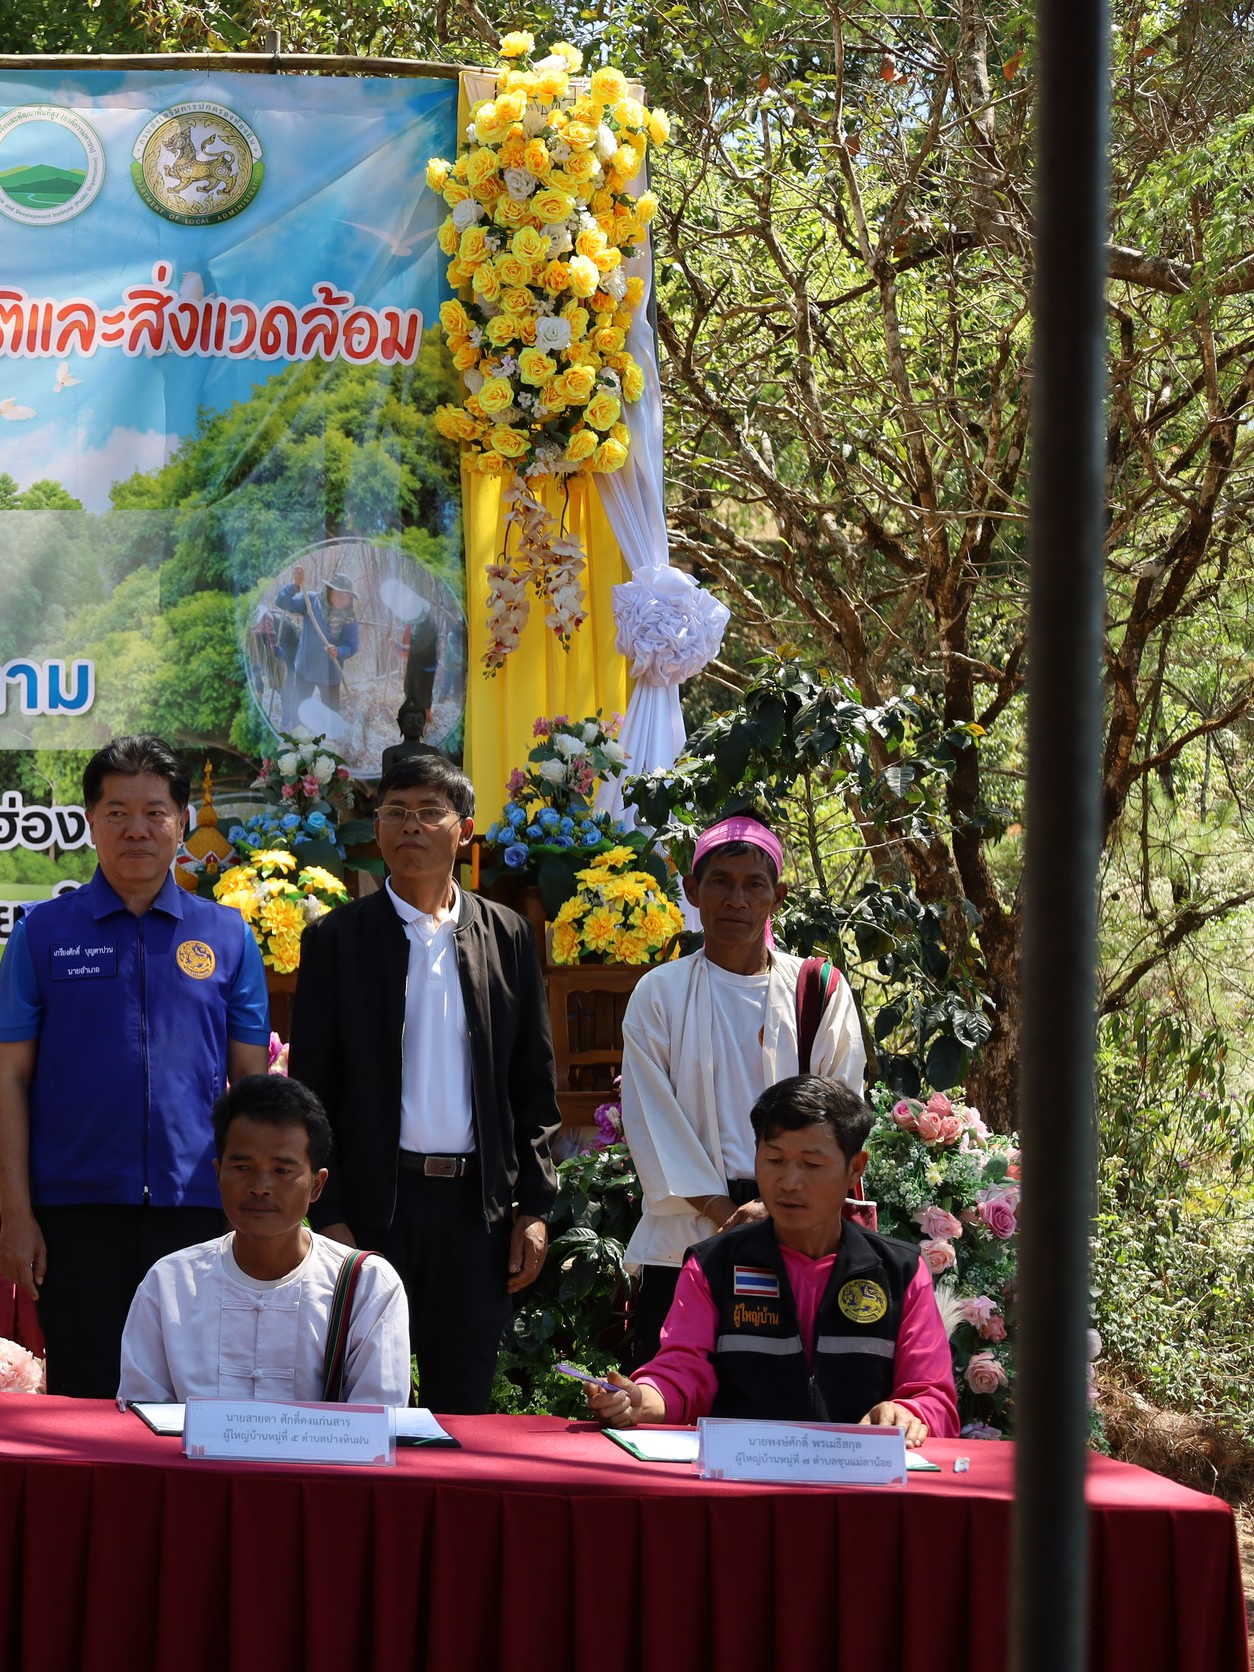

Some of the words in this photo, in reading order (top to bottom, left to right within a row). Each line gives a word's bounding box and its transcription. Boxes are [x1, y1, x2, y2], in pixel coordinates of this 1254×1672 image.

[135, 167, 166, 214] DEPARTMENT
[168, 213, 180, 222] OF
[184, 217, 211, 225] LOCAL
[216, 167, 263, 222] ADMINISTRATION
[4, 202, 15, 212] and
[15, 208, 52, 220] Development
[52, 205, 75, 218] Institute
[67, 965, 101, 976] นายอำเภอ
[733, 1302, 780, 1328] ผู้ใหญ่บ้าน
[223, 1428, 289, 1445] ผู้ใหญ่บ้านหมู่ที่
[301, 1432, 370, 1445] ตำบลปางหินฝน
[735, 1452, 801, 1469] ผู้ใหญ่บ้านหมู่ที่
